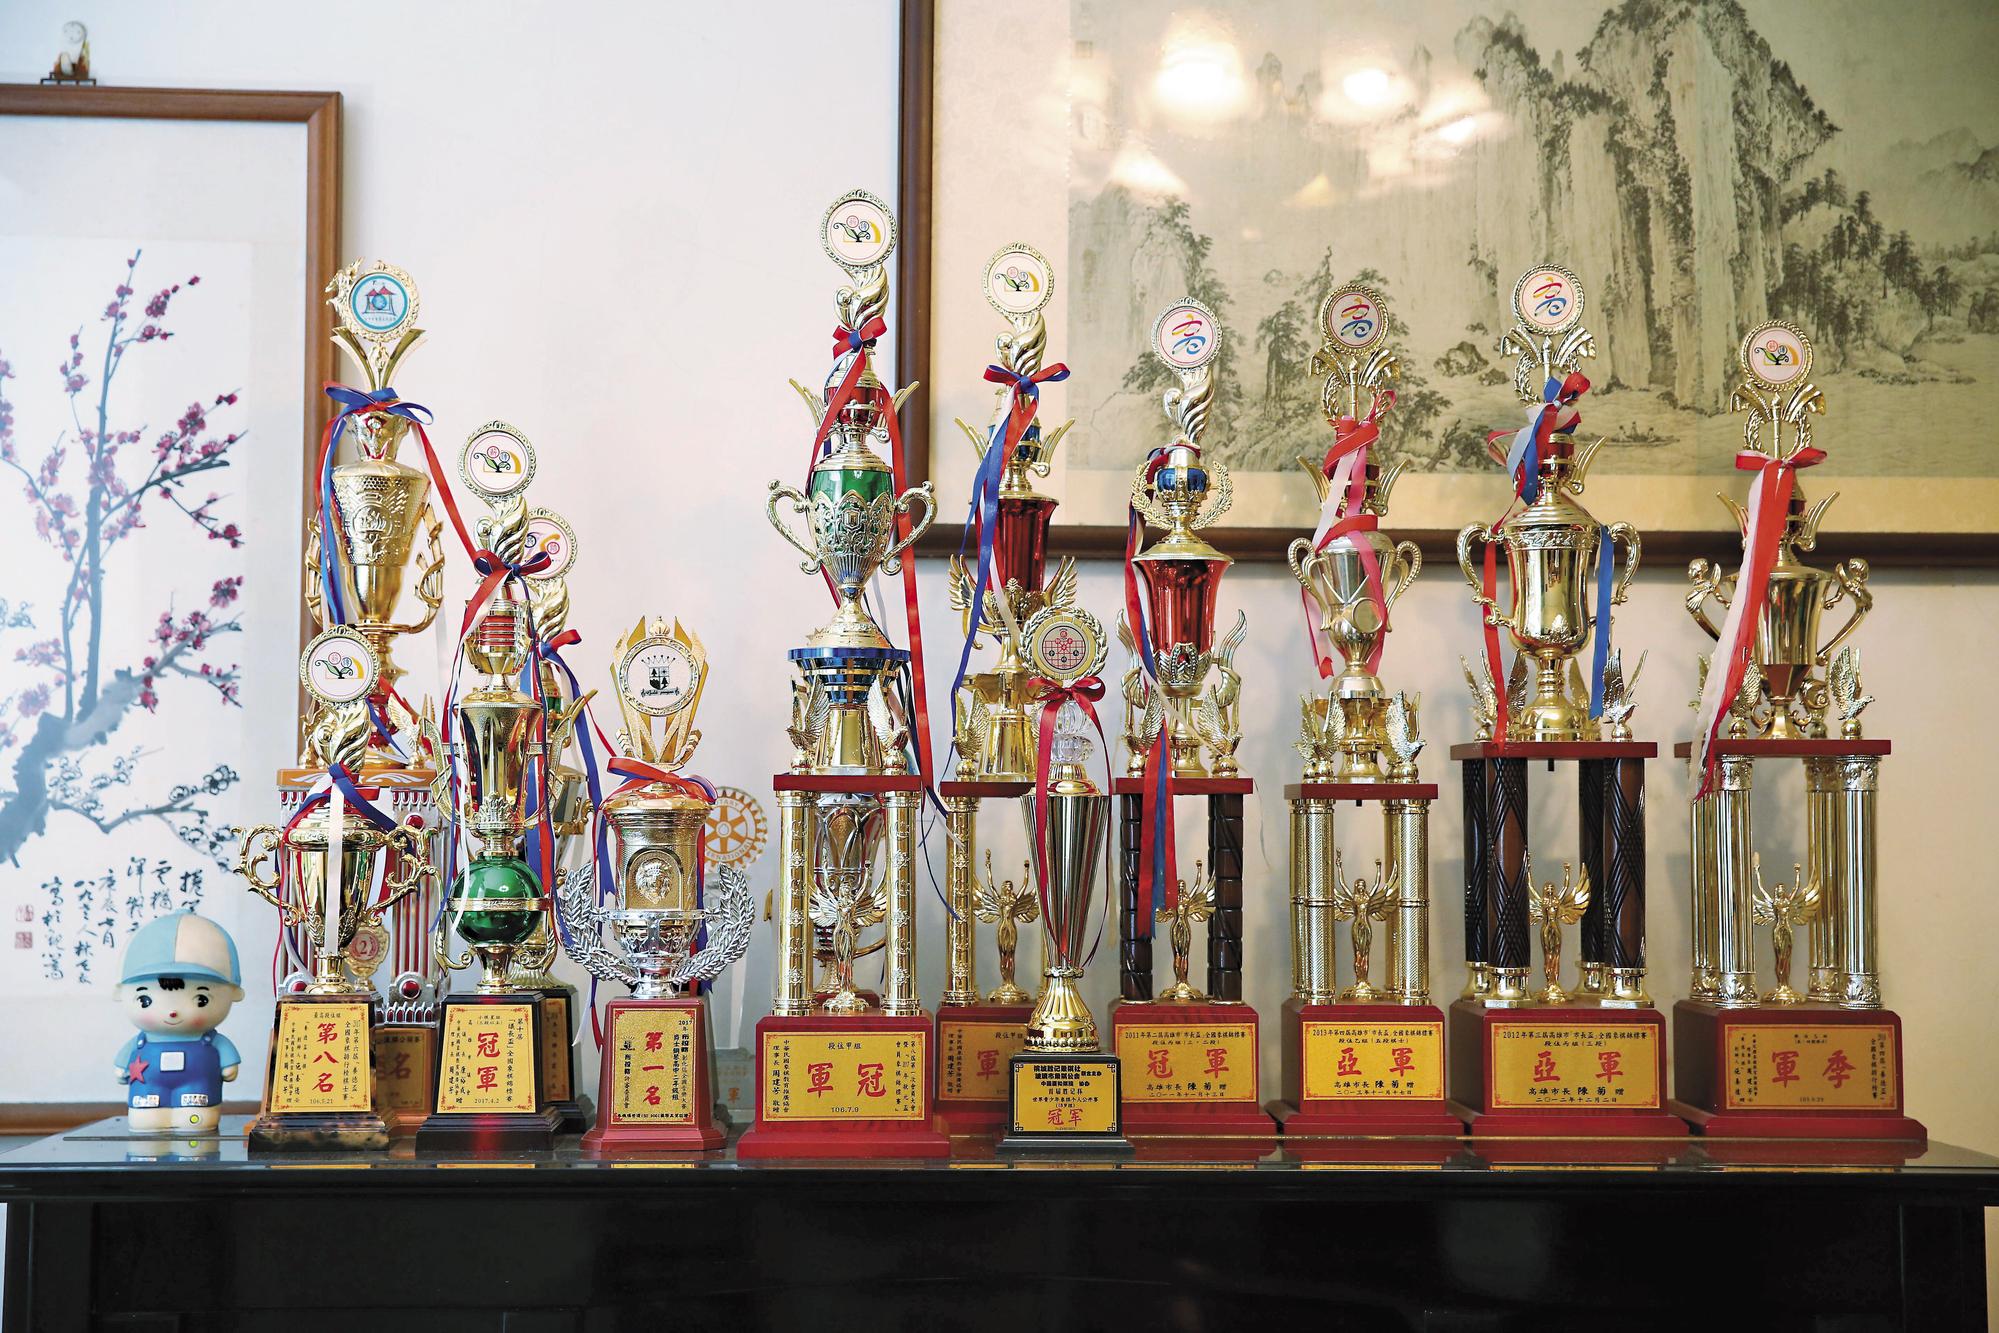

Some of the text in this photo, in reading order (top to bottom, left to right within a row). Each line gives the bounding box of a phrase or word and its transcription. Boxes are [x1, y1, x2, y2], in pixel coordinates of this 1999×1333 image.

[312, 1022, 339, 1093] 第八名
[476, 1032, 500, 1093] 冠軍
[642, 1031, 665, 1106] 第一名
[1146, 1047, 1229, 1079] 冠軍
[1337, 1047, 1415, 1077] 亞軍
[1533, 1050, 1624, 1083] 亞軍
[1047, 1108, 1084, 1128] 冠军
